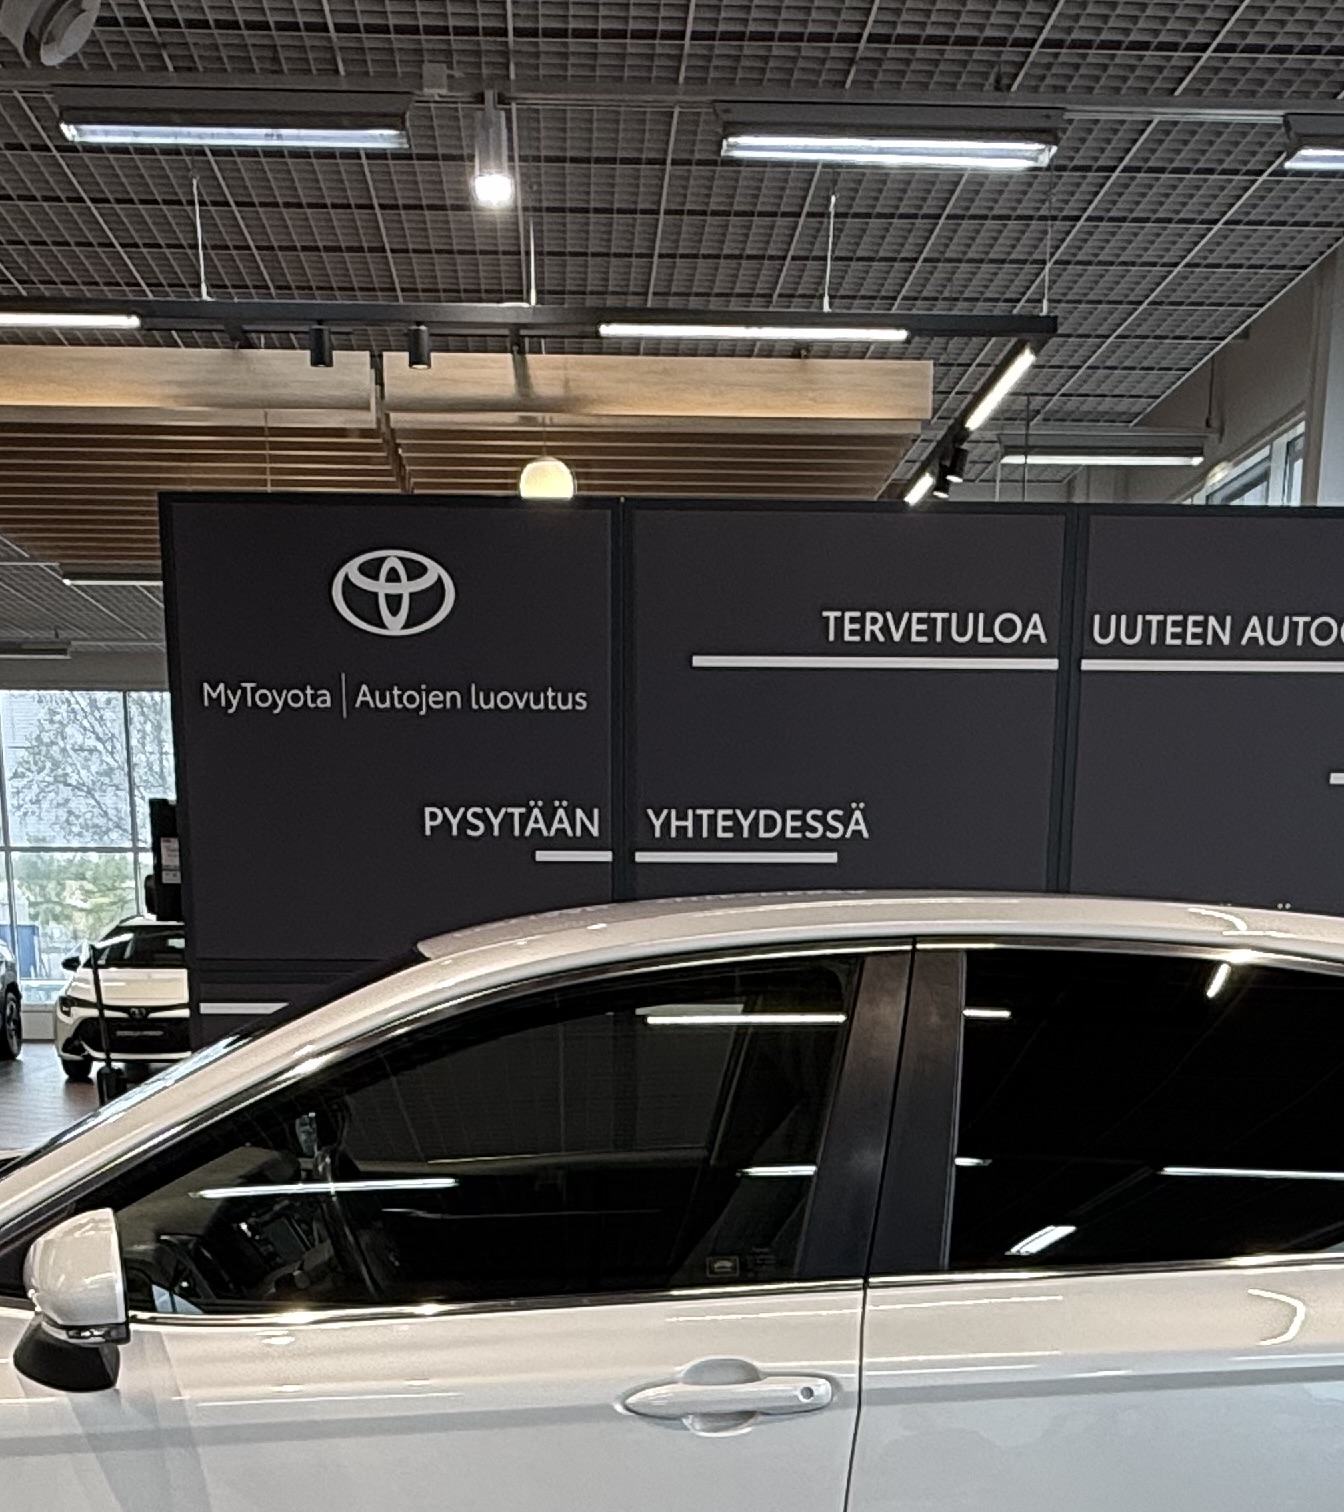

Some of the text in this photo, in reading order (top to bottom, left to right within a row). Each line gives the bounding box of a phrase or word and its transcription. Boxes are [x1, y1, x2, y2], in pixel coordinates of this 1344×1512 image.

[821, 610, 1048, 645] TERVETULOA
[1092, 614, 1233, 646] UUTEEN
[202, 682, 588, 716] MyToyota Autojen luovutus
[423, 800, 870, 839] PYSYTÄÄN YHTEYDESSÄ
